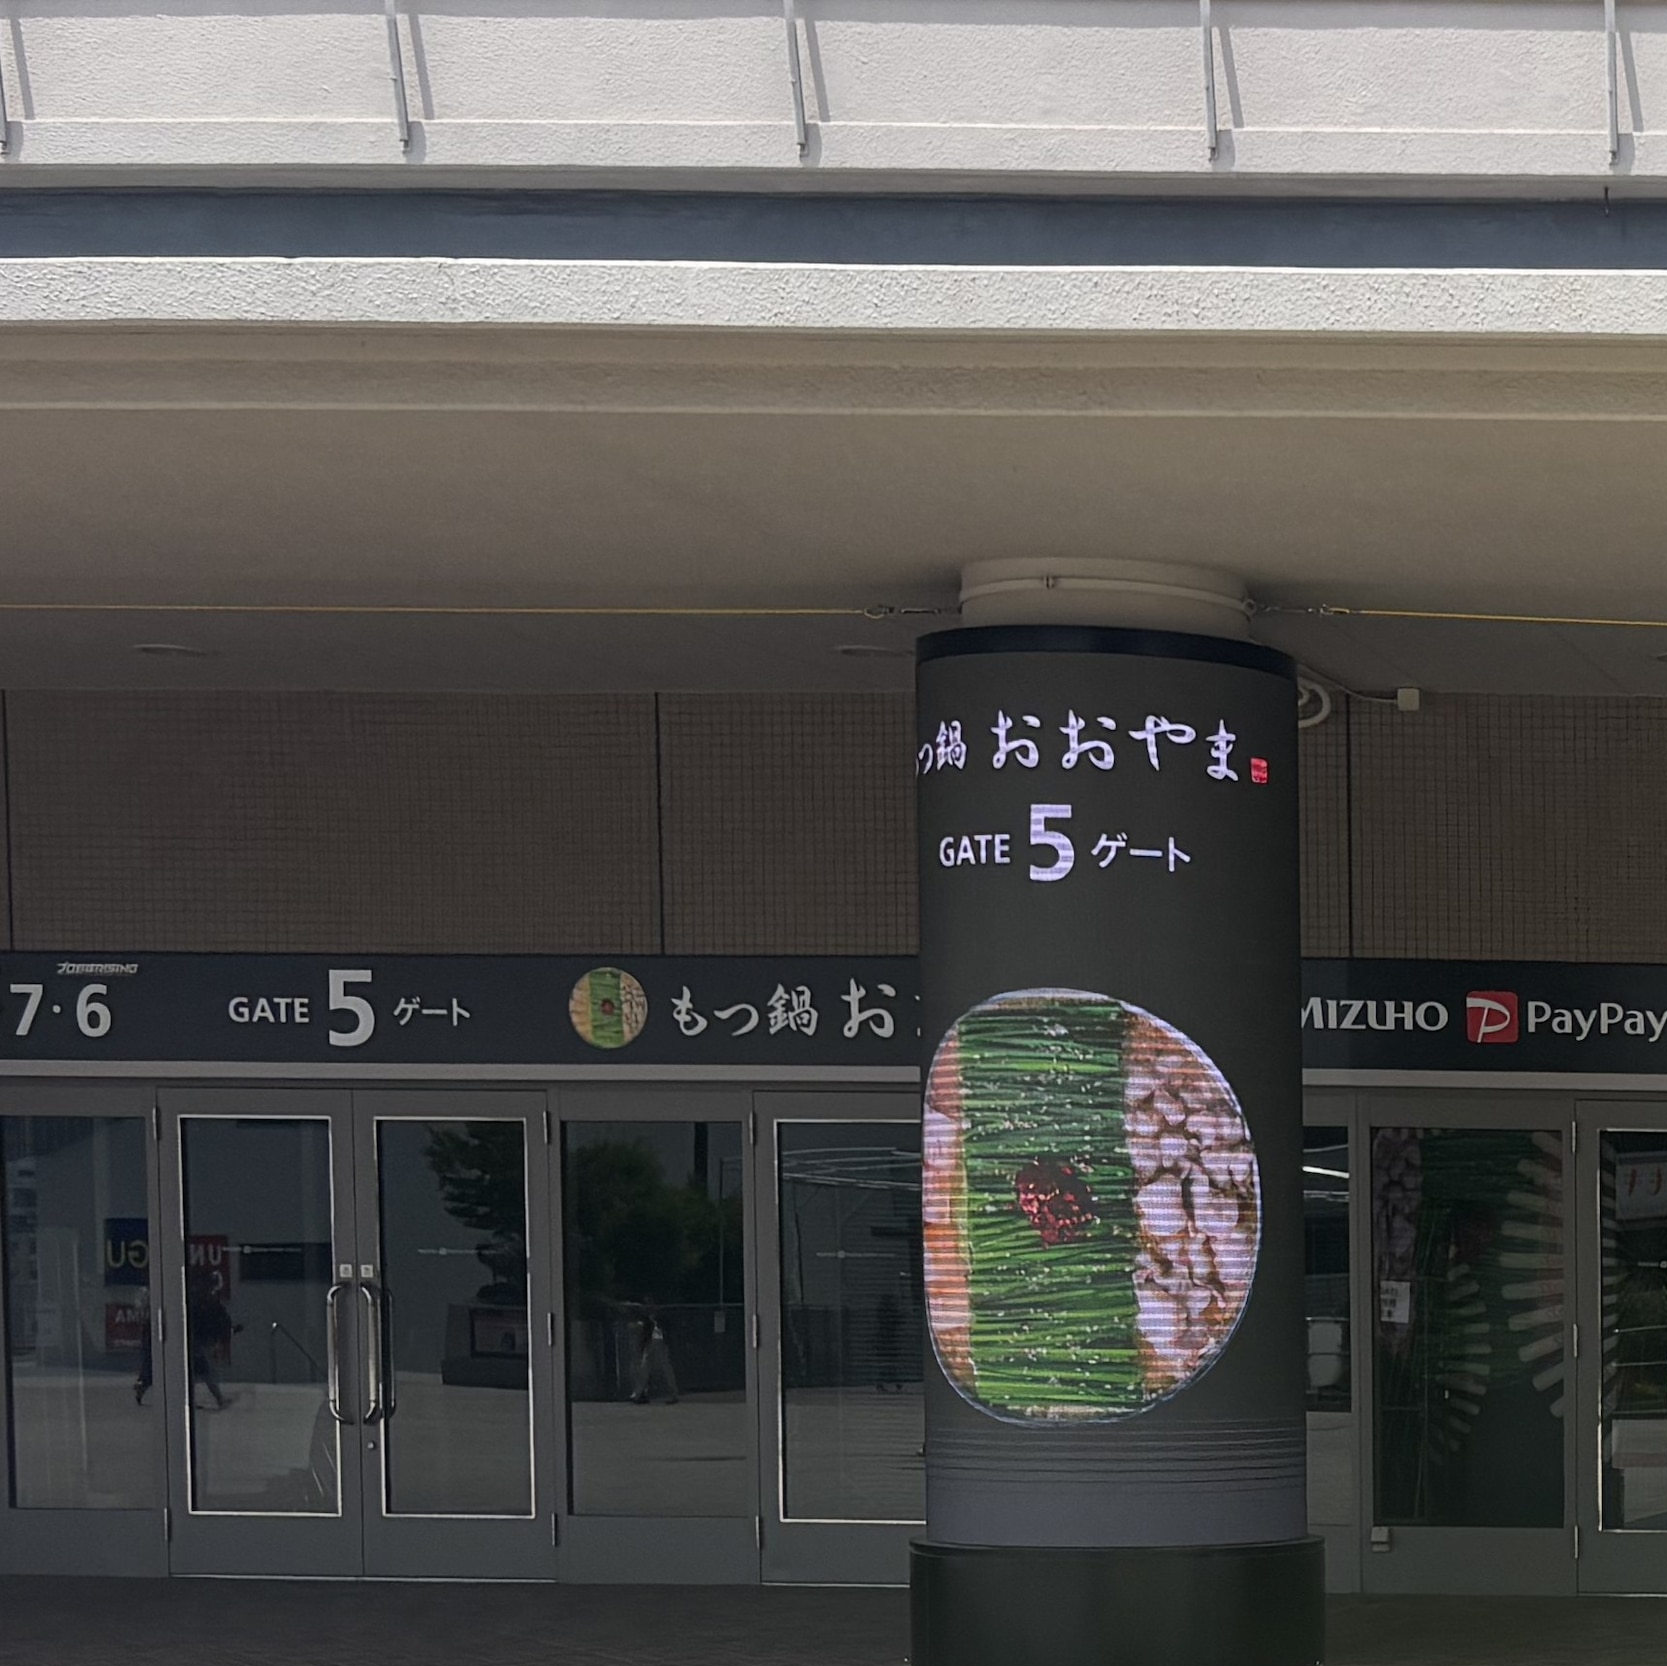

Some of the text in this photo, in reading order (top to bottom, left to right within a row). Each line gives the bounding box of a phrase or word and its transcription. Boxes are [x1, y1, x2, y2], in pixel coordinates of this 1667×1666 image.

[915, 719, 967, 775] つ鍋
[991, 710, 1239, 781] おおやま
[939, 804, 1191, 882] GATE 5 ゲート
[228, 969, 471, 1047] GATE 5 ゲート
[671, 978, 921, 1038] もつ鍋 お
[1301, 996, 1450, 1031] MIZUHO
